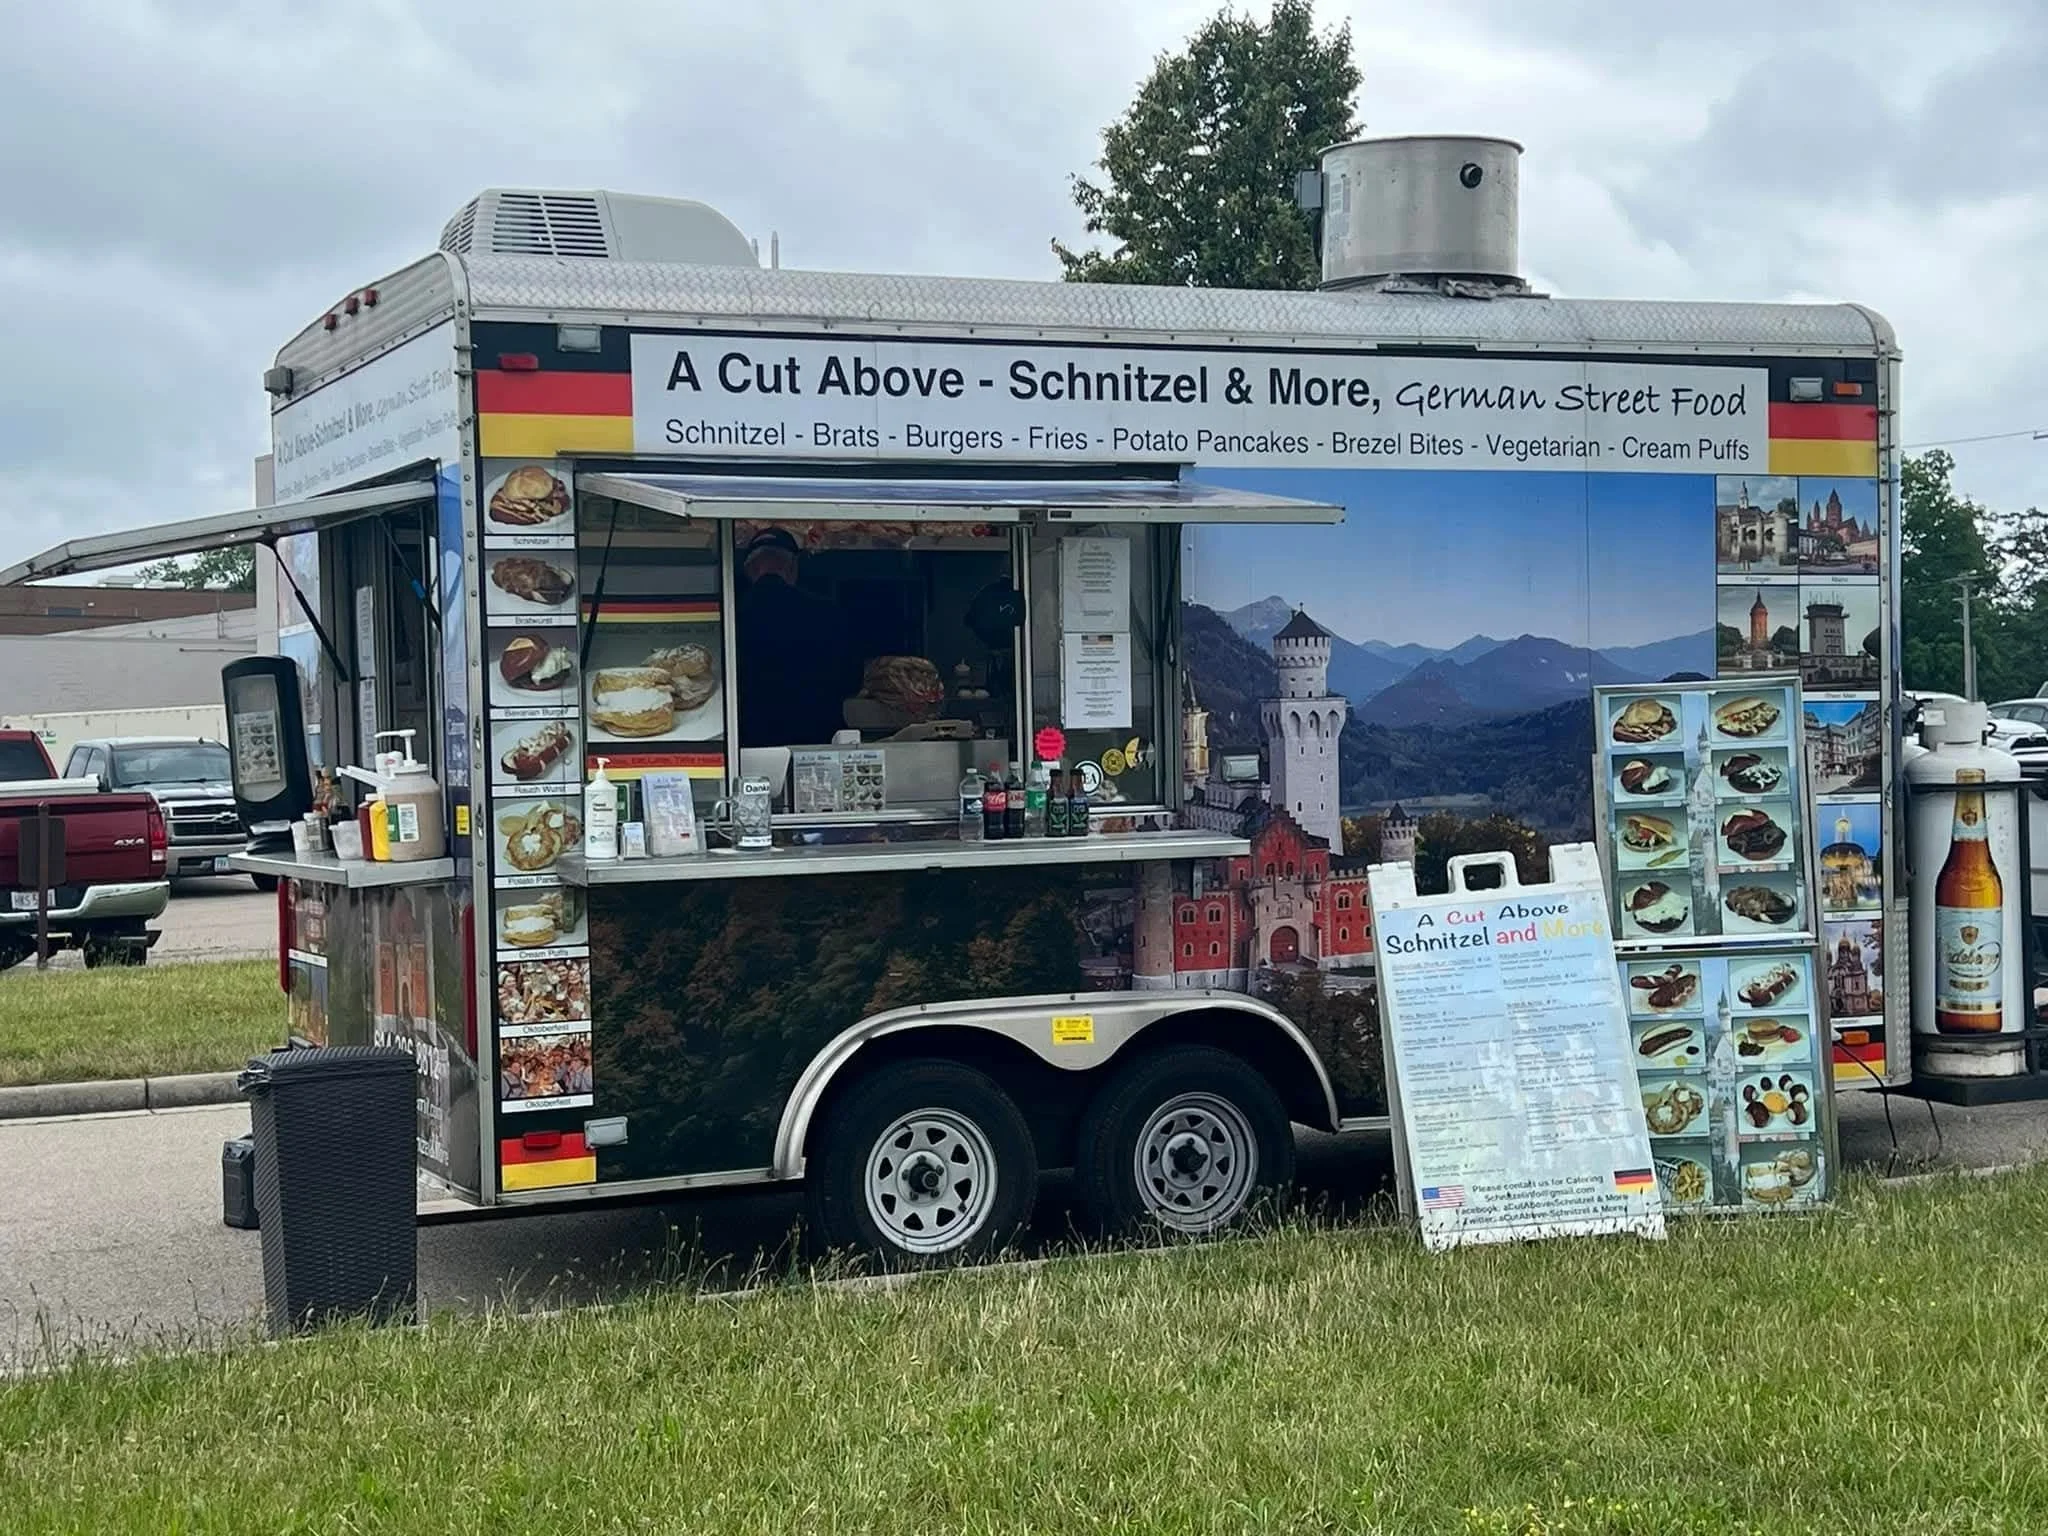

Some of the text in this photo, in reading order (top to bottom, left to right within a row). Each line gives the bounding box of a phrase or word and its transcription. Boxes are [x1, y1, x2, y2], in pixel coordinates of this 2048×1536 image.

[667, 351, 702, 392] A
[718, 352, 800, 394] Cut
[817, 356, 965, 398] Above
[1009, 359, 1208, 404] Schnitzel
[1224, 367, 1254, 405] &
[1269, 367, 1381, 415] More,
[1396, 380, 1546, 417] German
[1555, 382, 1661, 415] Street
[1671, 383, 1747, 417] Food
[665, 418, 786, 447] Schnitzel
[813, 421, 880, 449] Brats
[906, 424, 1003, 457] Burgers
[1029, 425, 1089, 451] Fries
[1113, 427, 1189, 453] Potato
[1196, 428, 1309, 455] Pancakes
[1332, 431, 1401, 456] Brezel
[1409, 432, 1464, 457] Bites
[1486, 433, 1601, 463] Vegetarian
[1622, 435, 1692, 460] Cream
[1699, 437, 1751, 462] Puffs
[1417, 903, 1570, 928] A Cut Above
[1386, 917, 1605, 955] Schnitzel and More
[522, 1023, 569, 1034] Oktoberfest
[1471, 1184, 1501, 1193] Please
[1538, 1180, 1549, 1188] us
[1551, 1177, 1564, 1186] for
[1566, 1175, 1604, 1185] Catering
